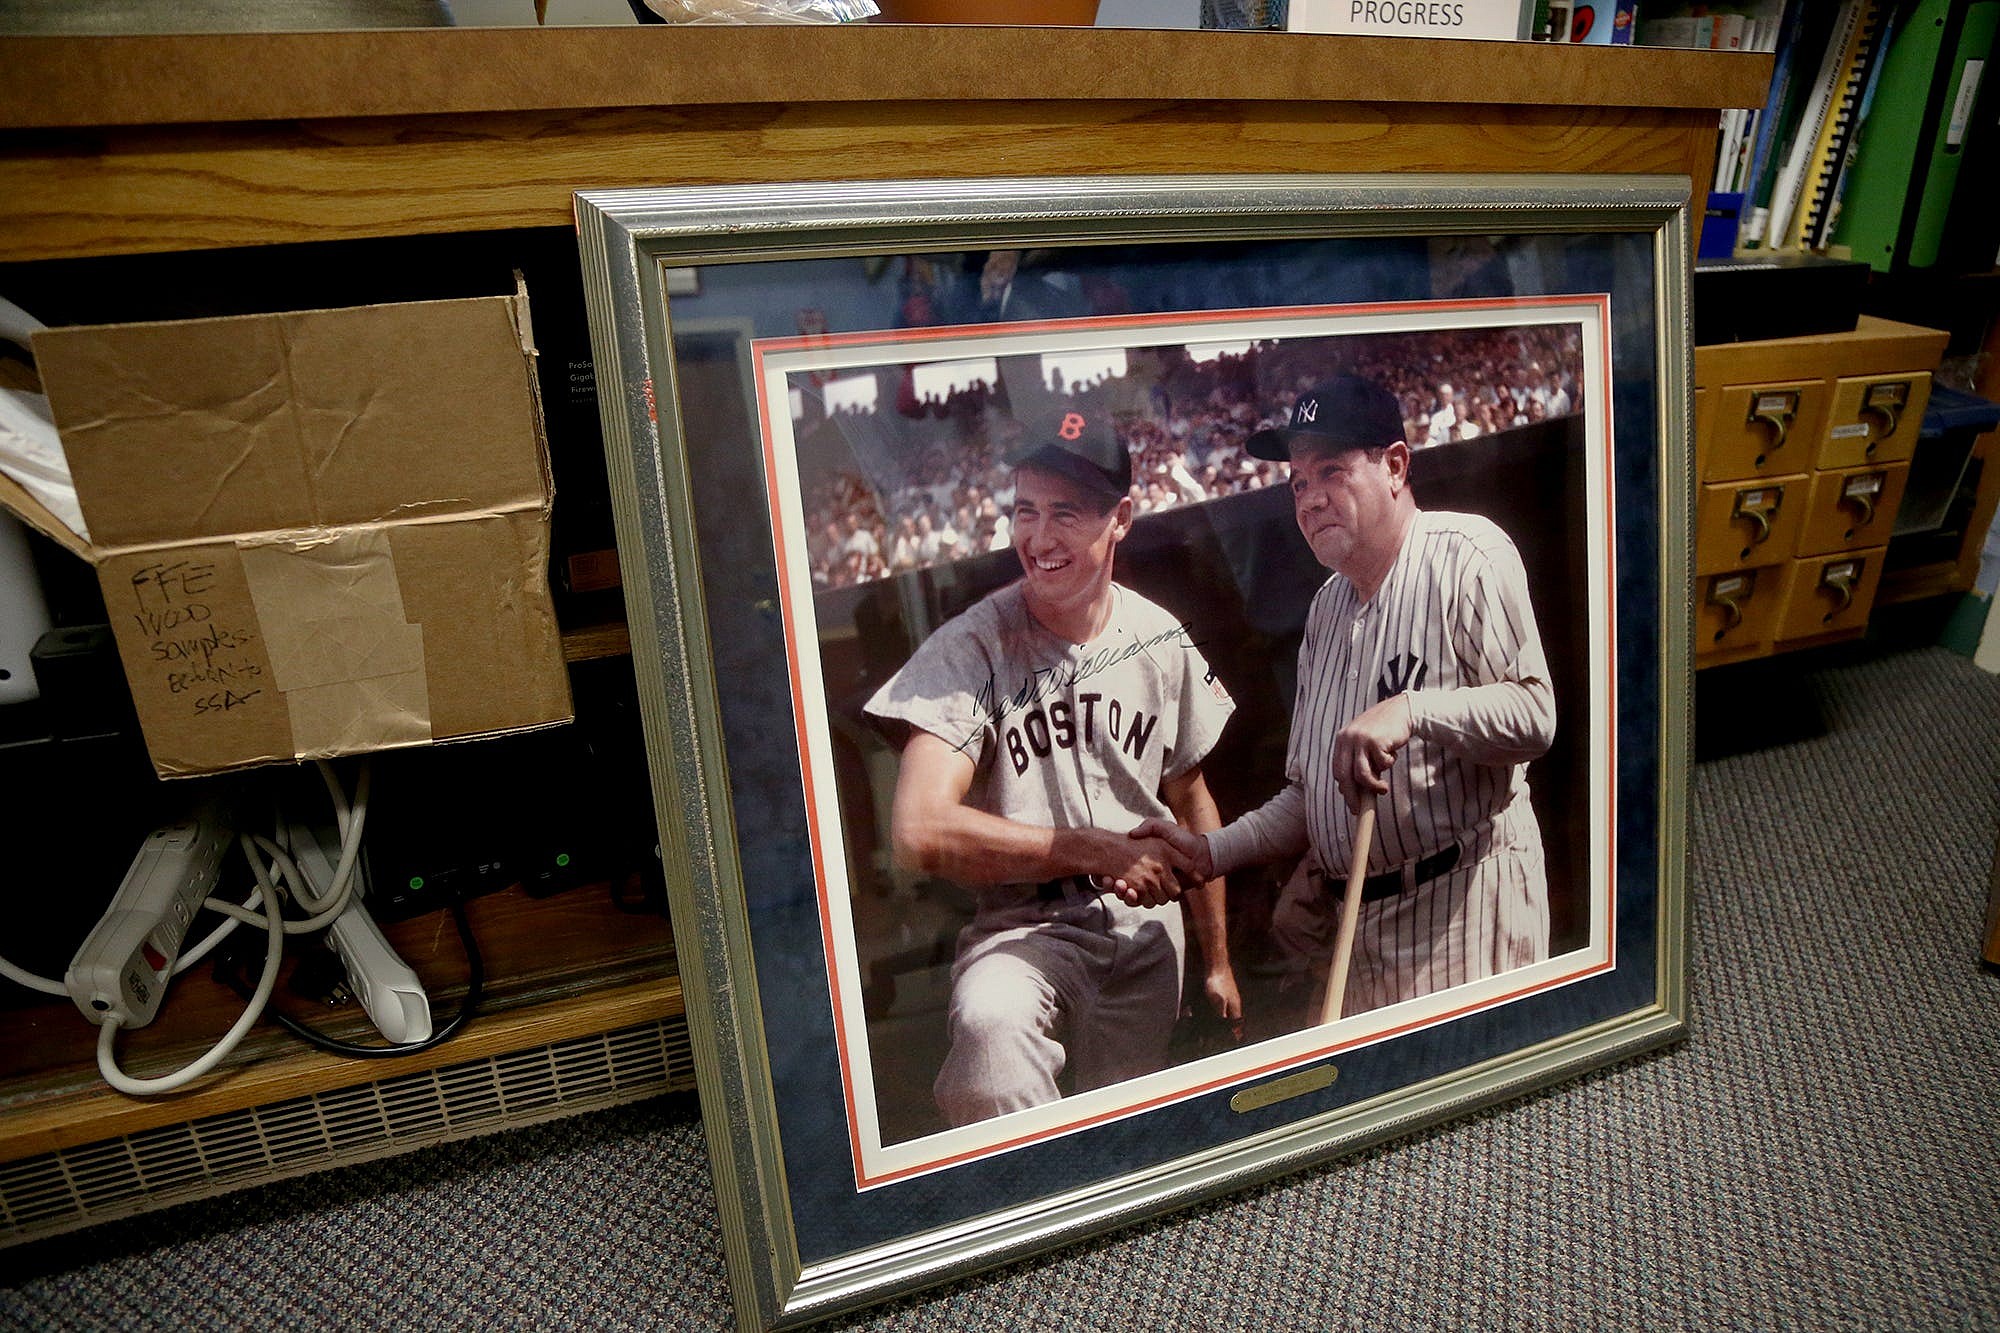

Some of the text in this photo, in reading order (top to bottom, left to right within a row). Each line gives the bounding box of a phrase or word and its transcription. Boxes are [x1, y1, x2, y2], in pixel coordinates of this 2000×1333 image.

[1350, 0, 1464, 26] PROGRESS
[1058, 411, 1086, 441] B
[1297, 399, 1319, 423] NY
[132, 561, 217, 613] FFE
[1034, 622, 1208, 702] Williams
[1006, 693, 1157, 778] BOSTON
